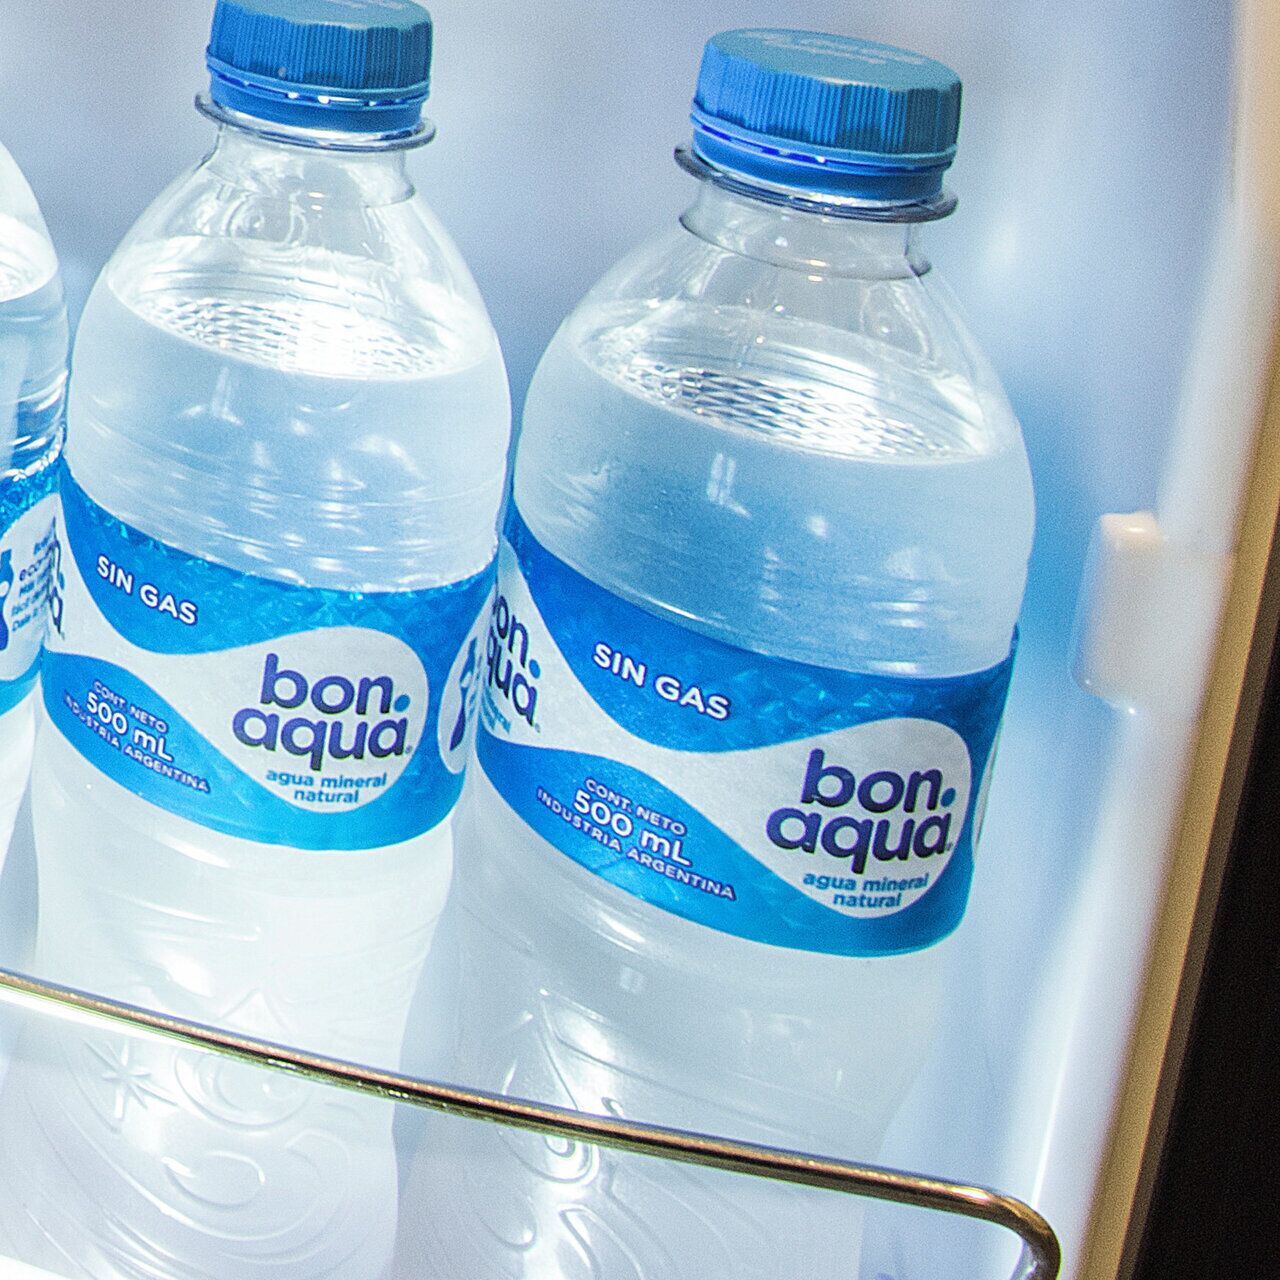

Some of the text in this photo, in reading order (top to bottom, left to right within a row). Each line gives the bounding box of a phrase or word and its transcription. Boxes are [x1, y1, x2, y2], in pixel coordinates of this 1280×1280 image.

[96, 555, 134, 596] SIN
[139, 582, 200, 627] GAS
[93, 679, 169, 735] CONT. NETO
[592, 642, 731, 722] SIN GAS
[86, 691, 175, 762] 500 mL
[232, 707, 407, 772] aqua
[124, 744, 211, 794] ARGENTINA
[266, 768, 387, 790] agua mineral
[293, 788, 359, 805] natural
[572, 788, 693, 868] 500 mL
[584, 777, 687, 837] CONT. NETO
[537, 786, 737, 902] INDUSTRIA ARGENTINA
[765, 806, 949, 874] aqua
[803, 871, 930, 892] agua mineral
[833, 890, 902, 909] natural
